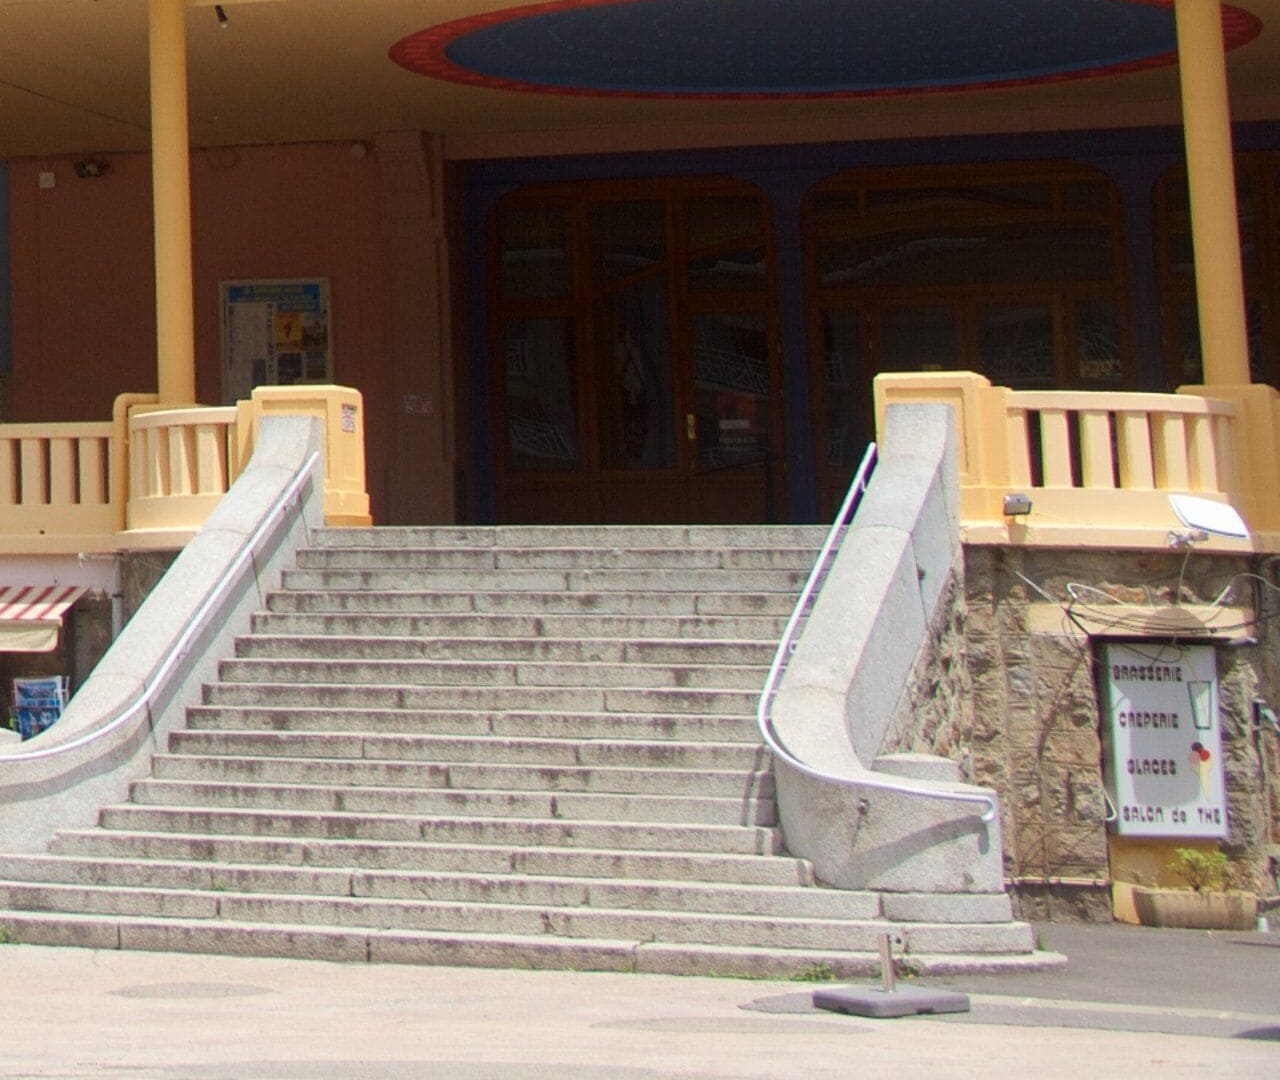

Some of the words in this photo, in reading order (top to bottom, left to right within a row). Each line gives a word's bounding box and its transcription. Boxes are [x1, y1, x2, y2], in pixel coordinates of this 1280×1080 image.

[1113, 664, 1182, 682] BRASSERIE
[1119, 711, 1179, 729] CREPERIE
[1127, 759, 1177, 776] GLACES
[1123, 805, 1164, 823] SALON
[1171, 808, 1187, 823] de
[1197, 807, 1221, 825] THE
